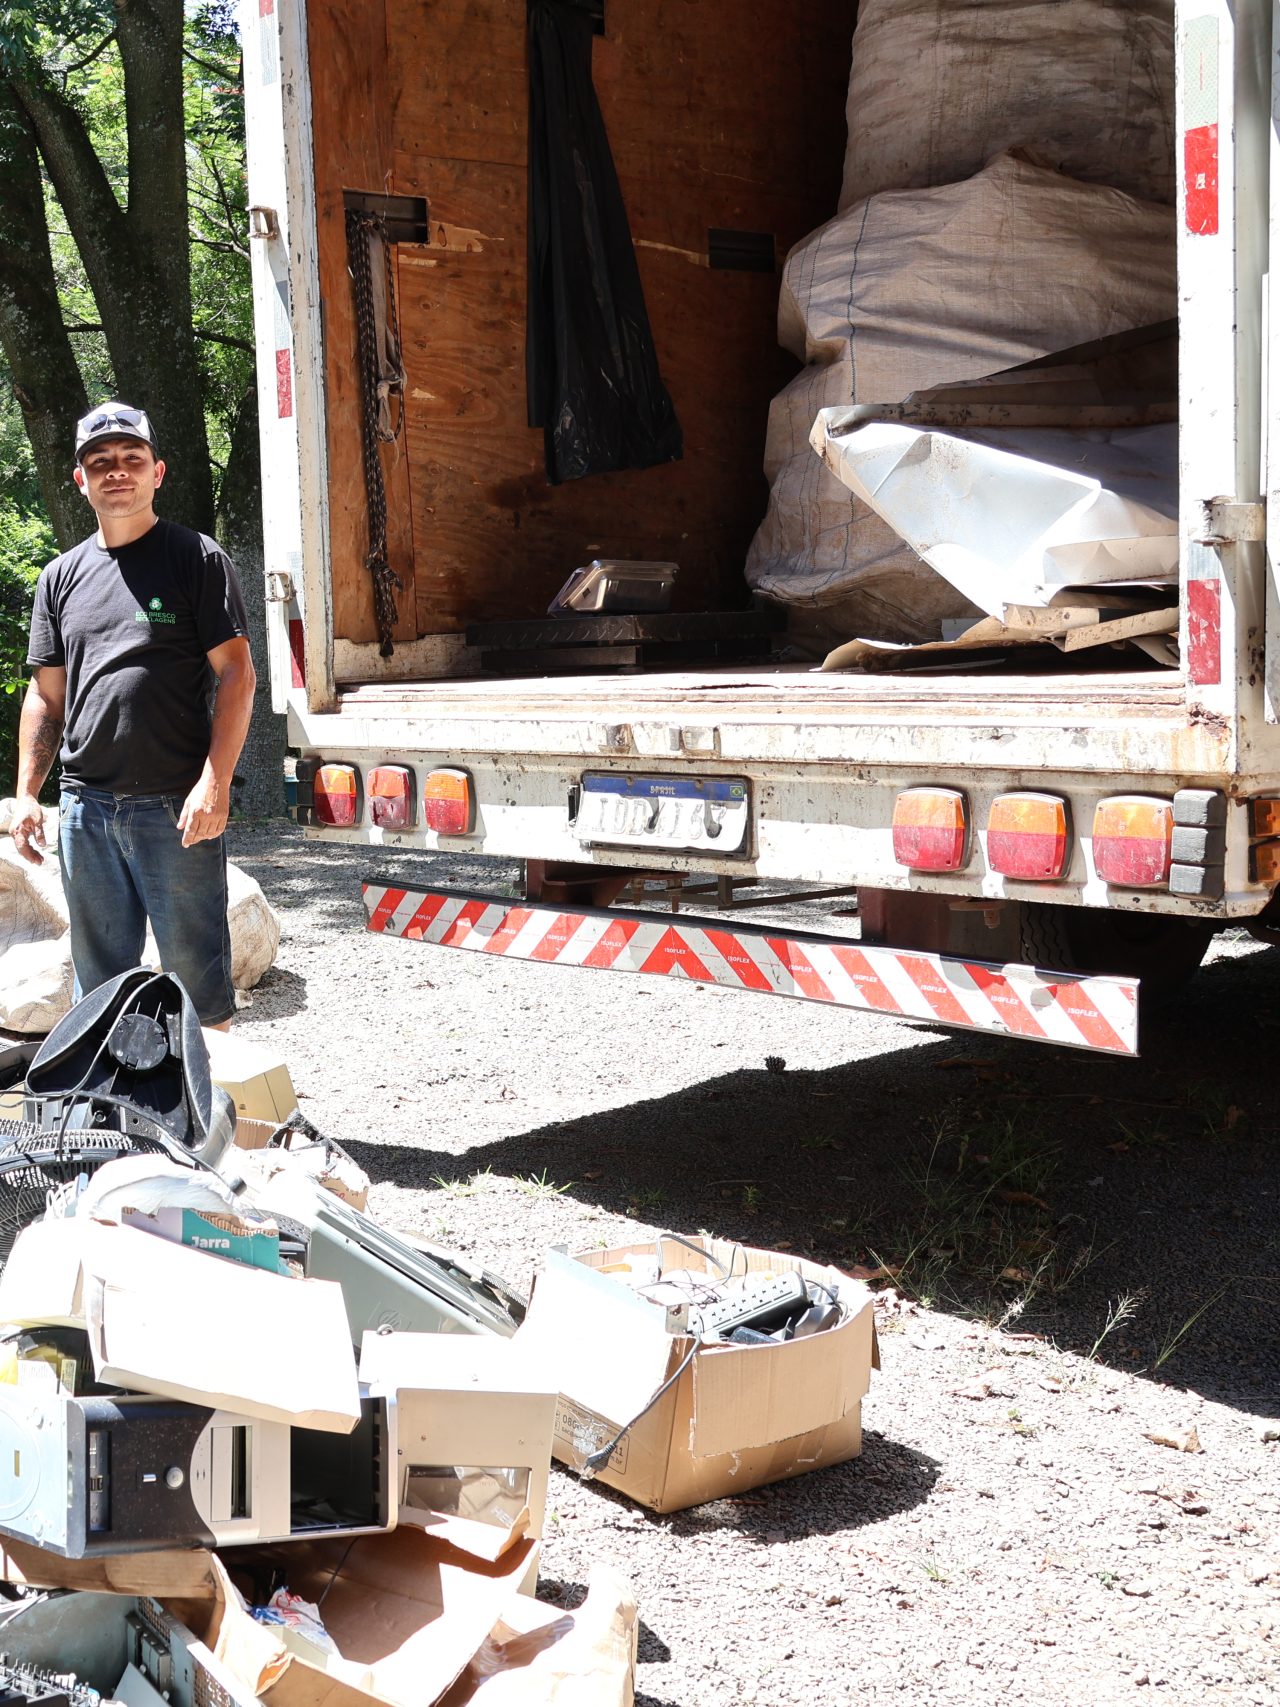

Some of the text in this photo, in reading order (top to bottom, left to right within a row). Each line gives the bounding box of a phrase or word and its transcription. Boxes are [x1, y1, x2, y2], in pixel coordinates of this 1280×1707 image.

[650, 785, 676, 795] BRASIL
[664, 947, 686, 955] ISOFLEX
[727, 955, 750, 964] ISOFLEX
[788, 964, 813, 973] ISOFLEX
[852, 973, 880, 983] ISOFLEX
[920, 984, 948, 994] ISOFLEX
[990, 995, 1019, 1005] ISOFLEX
[1067, 1007, 1099, 1017] ISOFLEX
[191, 1236, 231, 1249] Jarra
